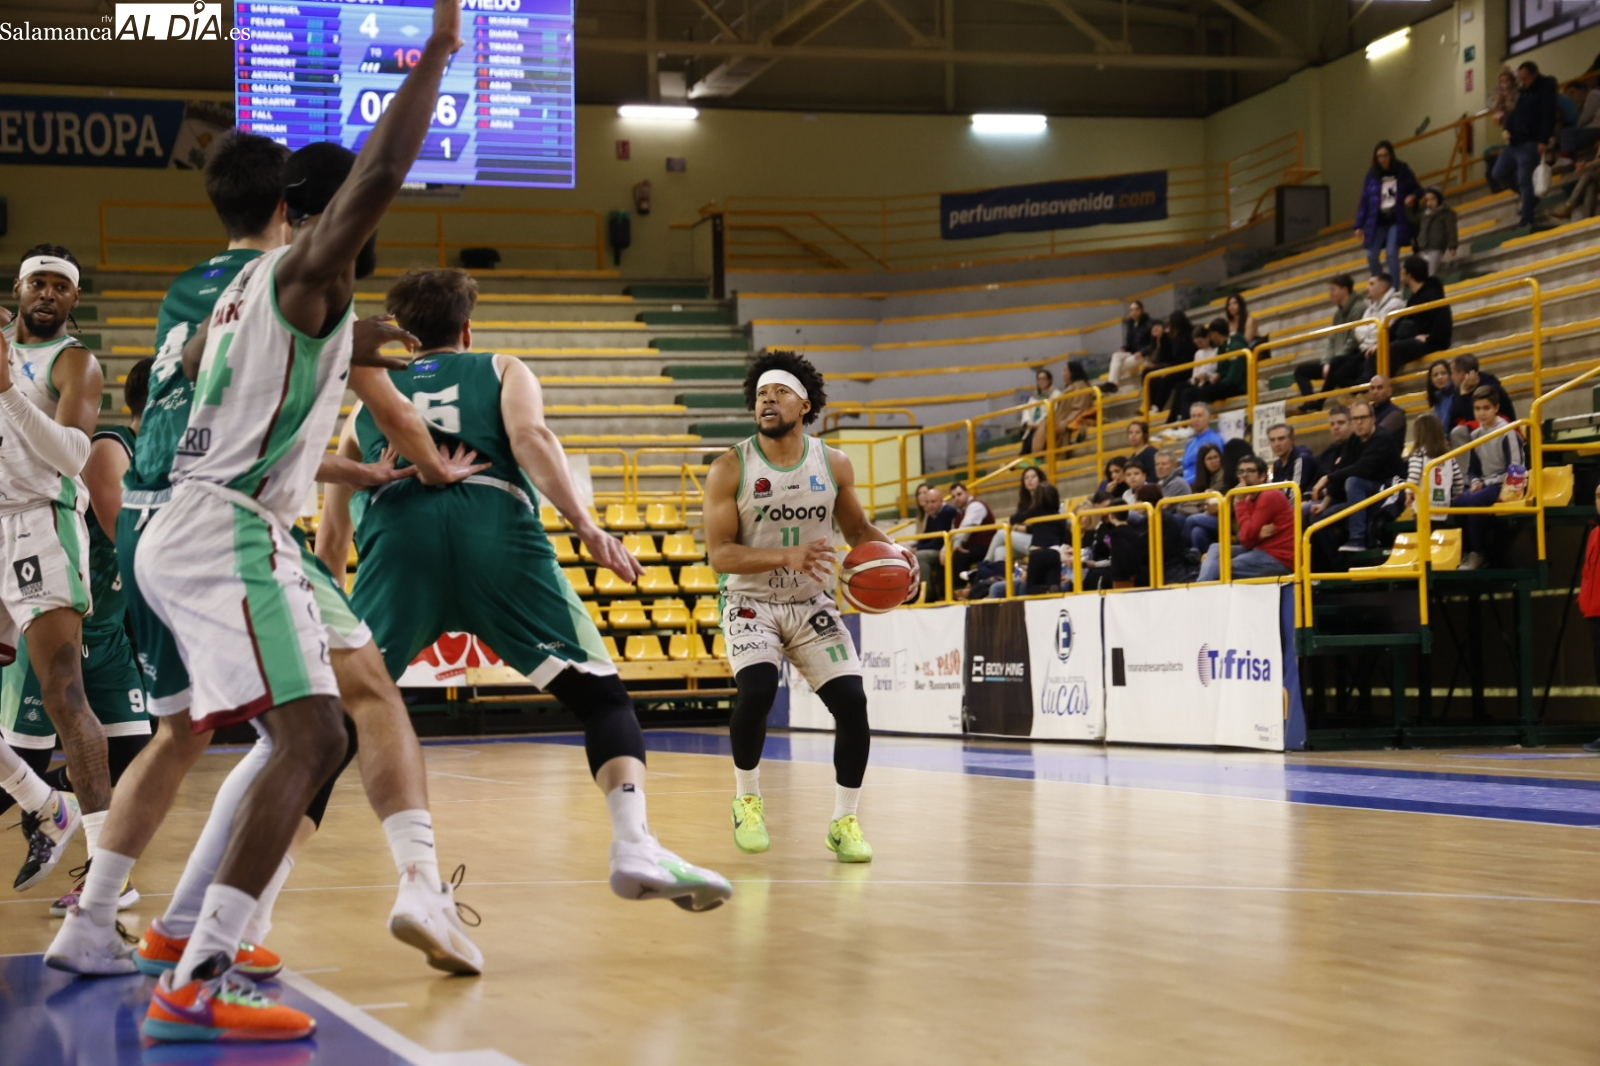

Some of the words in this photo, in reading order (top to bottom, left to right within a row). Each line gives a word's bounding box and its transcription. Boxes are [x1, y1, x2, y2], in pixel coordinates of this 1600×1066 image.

[250, 4, 268, 14] SAN
[269, 5, 300, 15] MIGUEL
[250, 17, 285, 27] FELIZOR
[359, 12, 379, 39] 4
[250, 30, 294, 41] PANIAGUA
[250, 43, 290, 55] GARRIDO
[251, 83, 292, 95] GALLOSO
[251, 110, 273, 121] FALL
[0, 109, 165, 158] EUROPA
[440, 137, 451, 159] 1
[753, 503, 827, 523] Xoborg
[780, 526, 800, 547] 11
[768, 576, 799, 589] GUA
[825, 643, 849, 663] 11
[128, 688, 145, 713] 9
